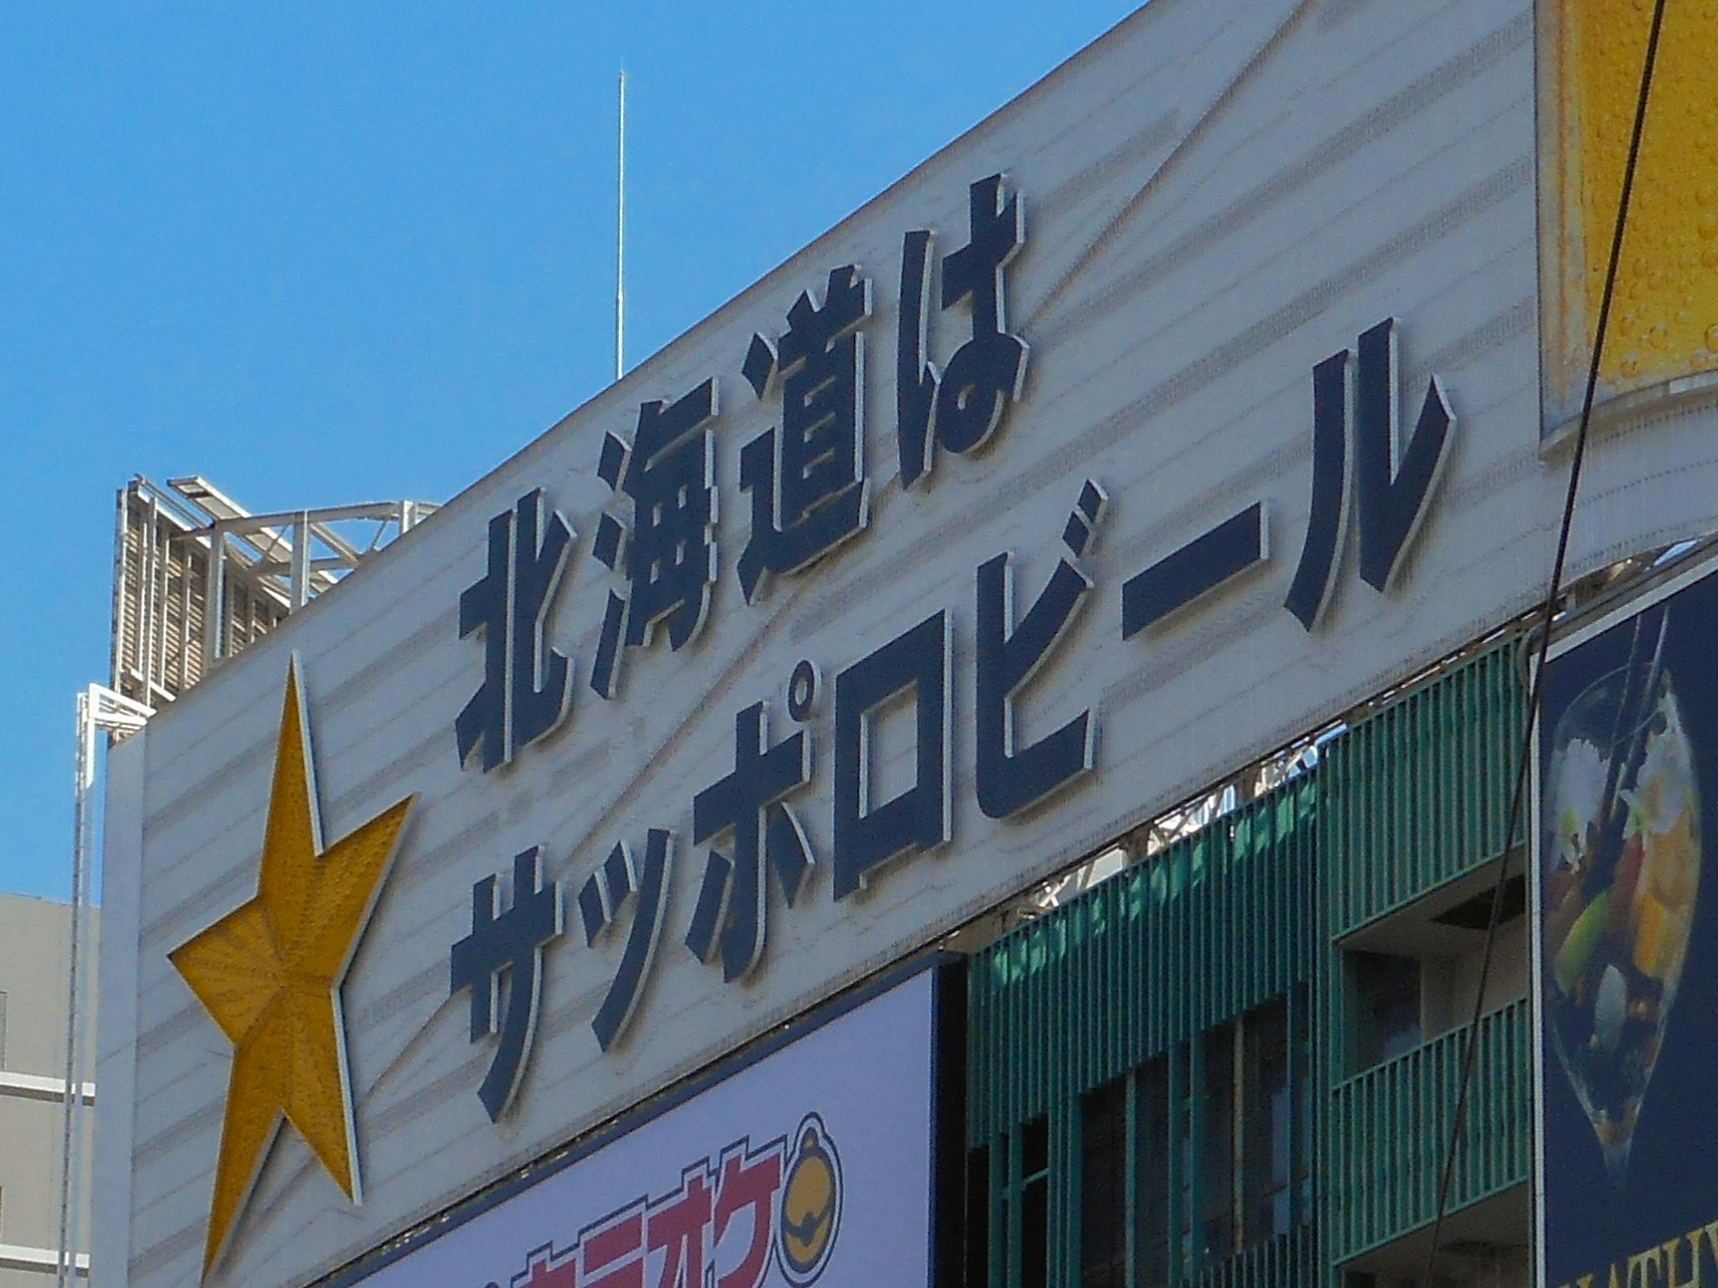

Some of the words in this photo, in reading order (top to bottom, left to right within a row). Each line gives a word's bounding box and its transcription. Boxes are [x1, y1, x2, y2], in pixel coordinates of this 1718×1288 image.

[449, 316, 1455, 1124] サッポロビール
[455, 172, 1028, 774] 北海道は
